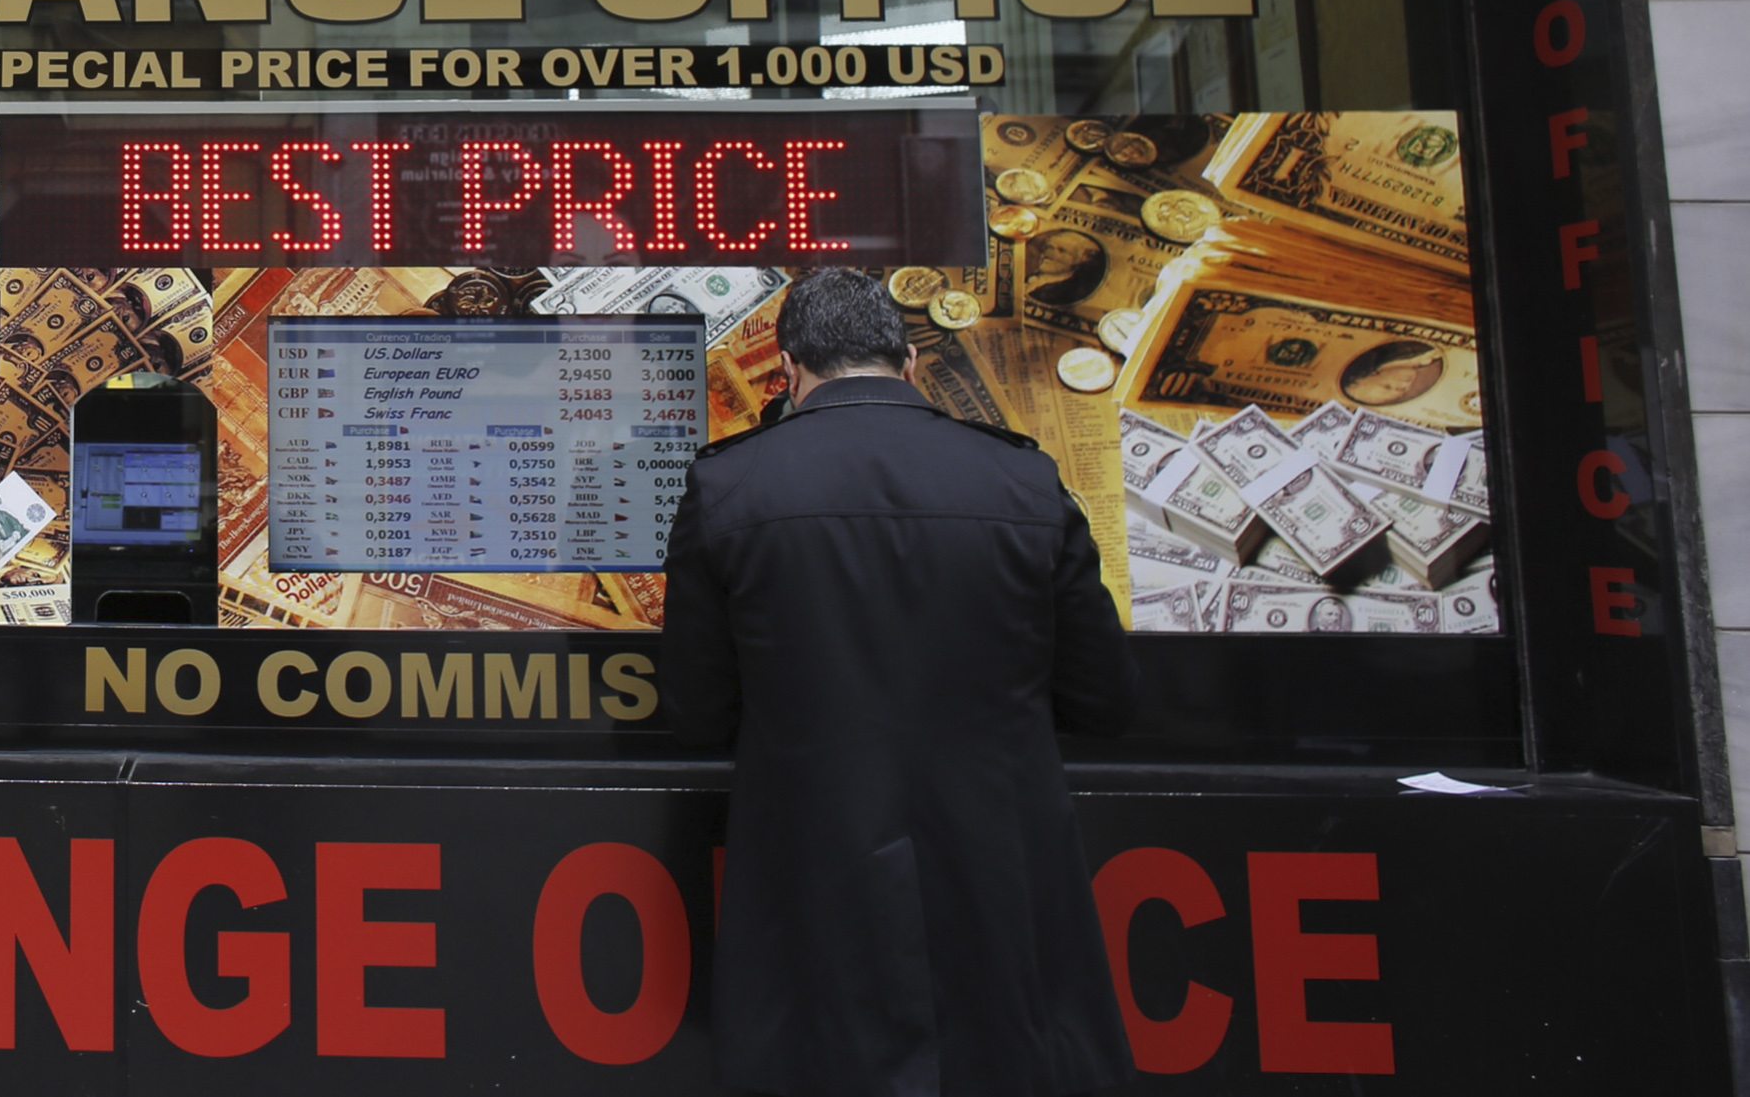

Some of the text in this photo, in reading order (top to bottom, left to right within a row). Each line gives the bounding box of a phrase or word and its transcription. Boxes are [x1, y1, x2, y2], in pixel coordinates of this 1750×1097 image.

[220, 48, 389, 89] PRICE
[410, 49, 524, 87] FOR
[541, 48, 698, 87] OVER
[716, 47, 868, 86] 1.000
[887, 45, 1005, 85] USD
[121, 139, 850, 252] BEST PRICE
[1533, 0, 1641, 637] OFFICE
[366, 333, 671, 345] Currency Trading Purchase Sale
[277, 348, 308, 360] USD
[558, 348, 612, 362] 2,1300
[641, 348, 695, 362] 2,1775
[277, 367, 695, 383] EUR European EURO 2,9450 3,0000
[277, 387, 696, 403] GBP English Pound 3,5183 3,6147
[277, 407, 697, 423] CHF Swiss Franc 2,4043 2,4678
[350, 426, 679, 436] Purchase Purchase Purchase
[286, 439, 309, 447] AUD
[365, 440, 411, 453] 1,8981
[508, 441, 555, 453] 0,0599
[653, 441, 699, 453] 2,9321
[286, 457, 309, 465] CAD
[365, 458, 411, 471] 1,9953
[509, 459, 556, 471] 0,5750
[637, 459, 693, 471] 0,00006
[287, 474, 311, 482] NOK
[365, 476, 411, 489] 0,3487
[509, 476, 556, 489] 5,3542
[286, 492, 311, 500] DKK
[365, 494, 411, 506] 0,3946
[509, 494, 556, 506] 0,5750
[286, 510, 308, 518] SEK
[365, 512, 411, 524] 0,3279
[509, 512, 556, 525] 0,5628
[286, 527, 306, 535] JPY
[365, 529, 411, 542] 0,0201
[510, 530, 557, 543] 7,3510
[286, 545, 310, 554] CNY
[365, 547, 412, 560] 0,3187
[510, 548, 558, 560] 0,2796
[2, 588, 56, 600] $50,000
[83, 645, 659, 721] NO COMMIS
[532, 841, 1396, 1076] OCE
